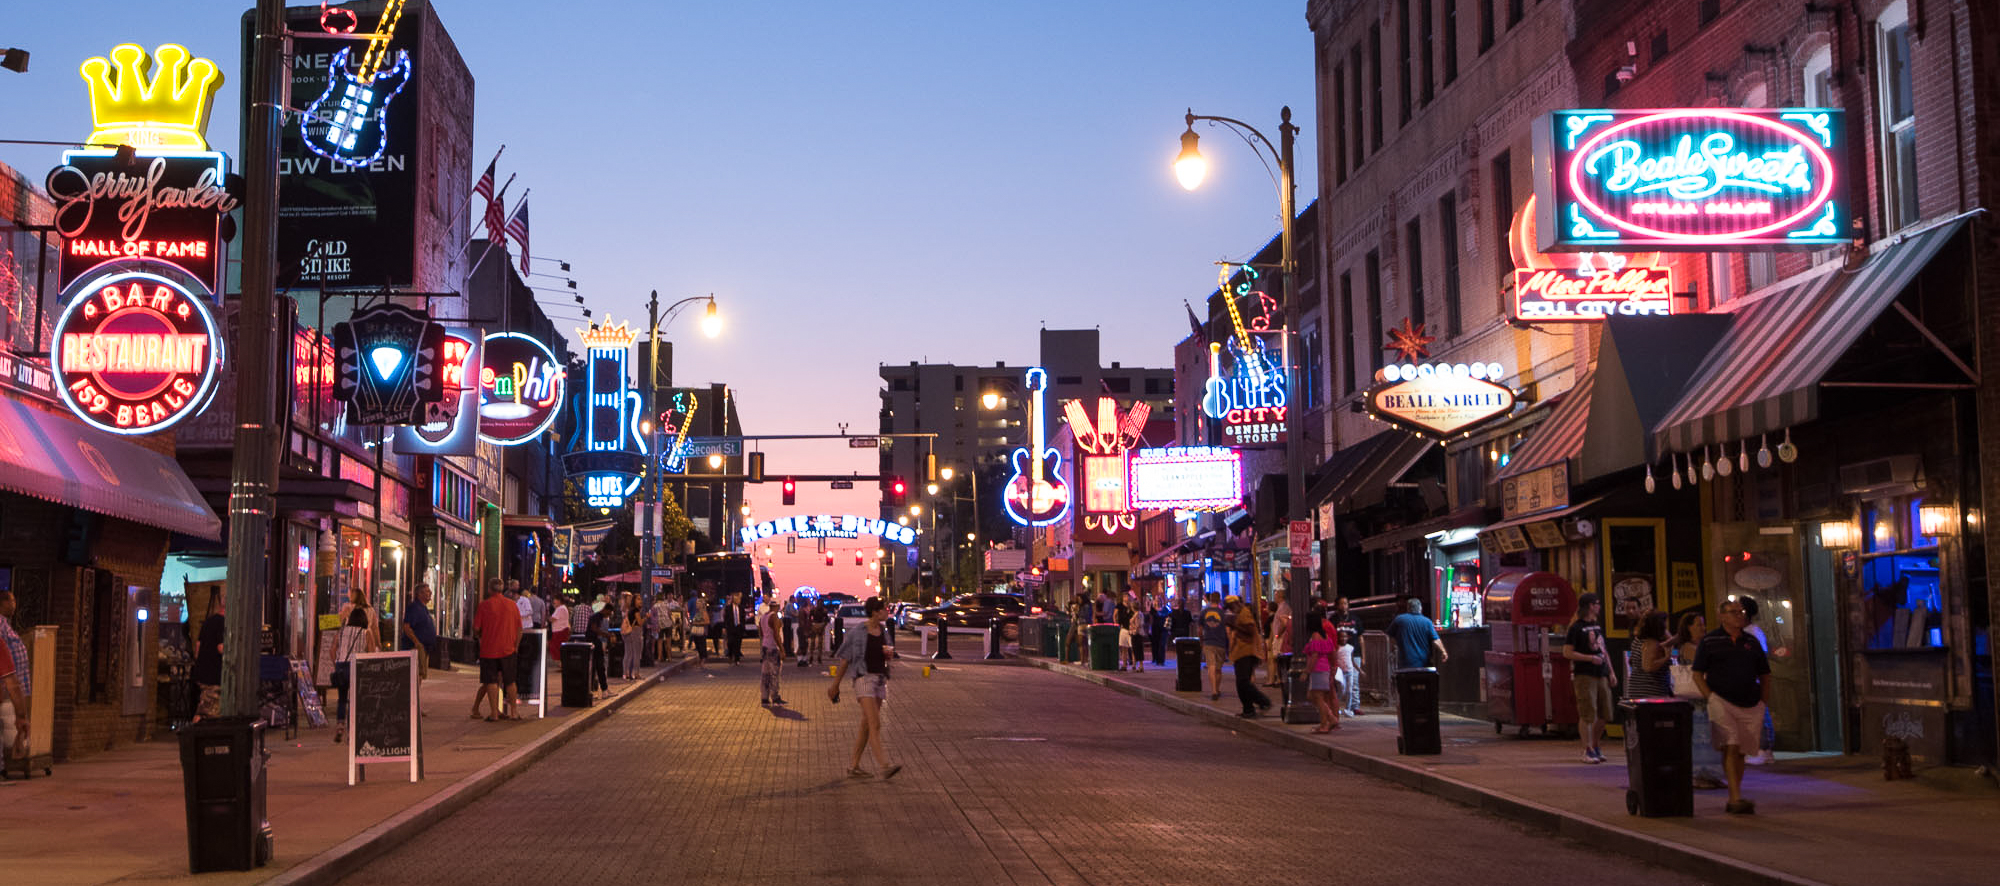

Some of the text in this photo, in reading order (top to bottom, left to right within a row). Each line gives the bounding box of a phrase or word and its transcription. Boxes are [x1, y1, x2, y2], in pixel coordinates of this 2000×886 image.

[1586, 132, 1813, 199] Beale Sweets
[47, 165, 146, 238] Jerry
[71, 240, 208, 258] HALL OF FAME
[1519, 270, 1588, 298] Miss
[101, 282, 175, 313] BAR
[1520, 301, 1669, 316] SOUL CITY CAFE
[62, 333, 208, 374] RESTAURANT
[481, 355, 567, 409] emphis
[69, 376, 196, 427] 159 BEALE
[1212, 373, 1286, 420] BLUES
[1384, 393, 1505, 409] BEALE STREET
[1226, 407, 1288, 425] CITY
[1225, 423, 1288, 436] GENERAL
[1236, 433, 1278, 444] STORE
[687, 442, 722, 455] Second
[1168, 447, 1186, 457] CITY
[588, 475, 624, 497] BLUES
[587, 496, 623, 507] CLUB
[740, 514, 809, 544] HOME
[814, 521, 835, 532] THE
[841, 514, 917, 545] BLUES
[1294, 523, 1308, 532] NO
[386, 746, 411, 756] LIGHT
